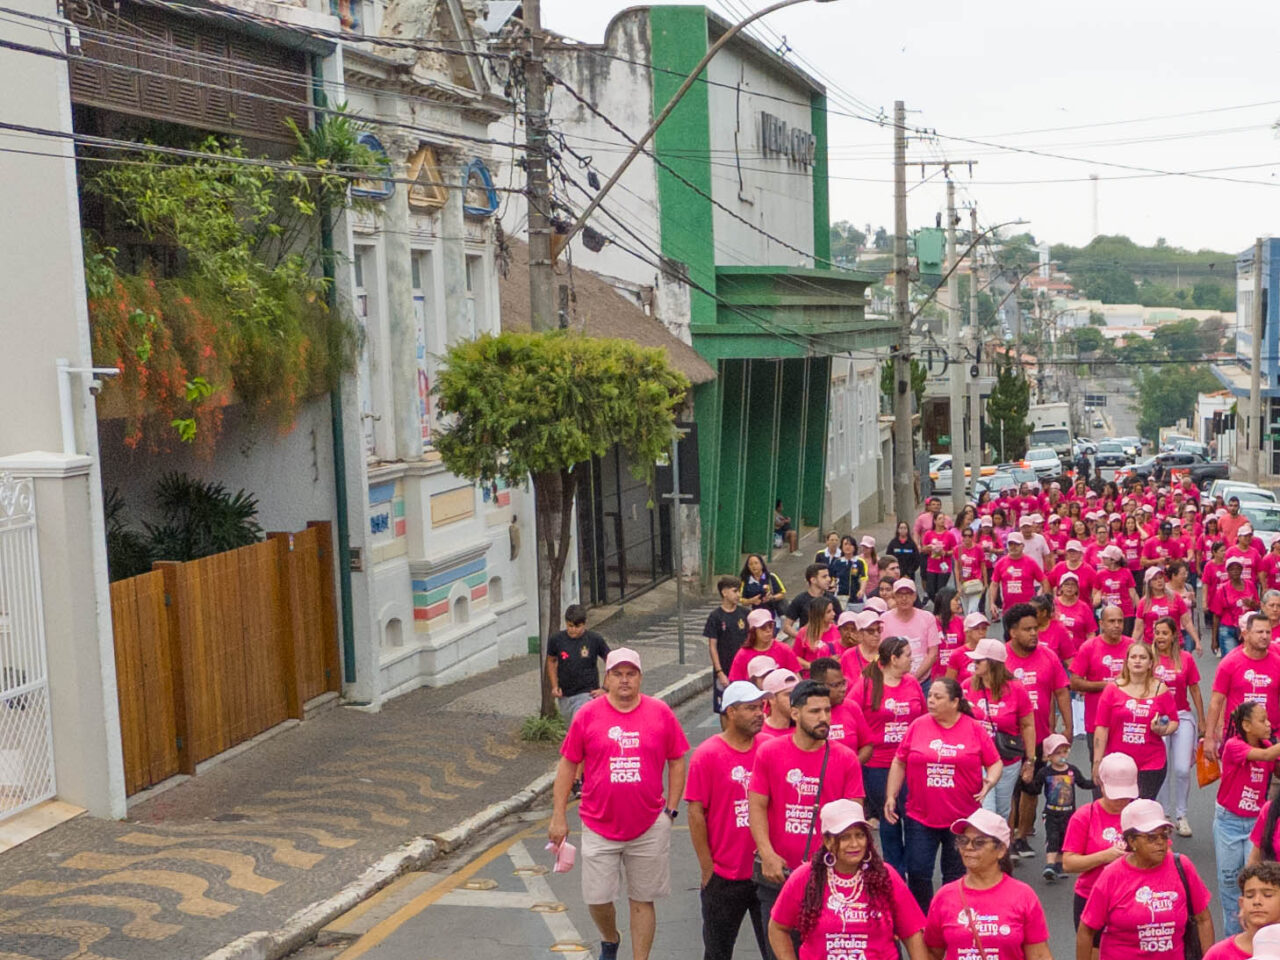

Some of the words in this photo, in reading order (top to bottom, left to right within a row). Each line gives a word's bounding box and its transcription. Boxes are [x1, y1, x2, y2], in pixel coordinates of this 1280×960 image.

[610, 772, 641, 783] ROSA
[926, 777, 955, 788] ROSA
[785, 807, 815, 819] pétala
[1138, 927, 1175, 939] pétalas
[826, 938, 868, 951] pétalas
[1139, 940, 1174, 952] ROSA
